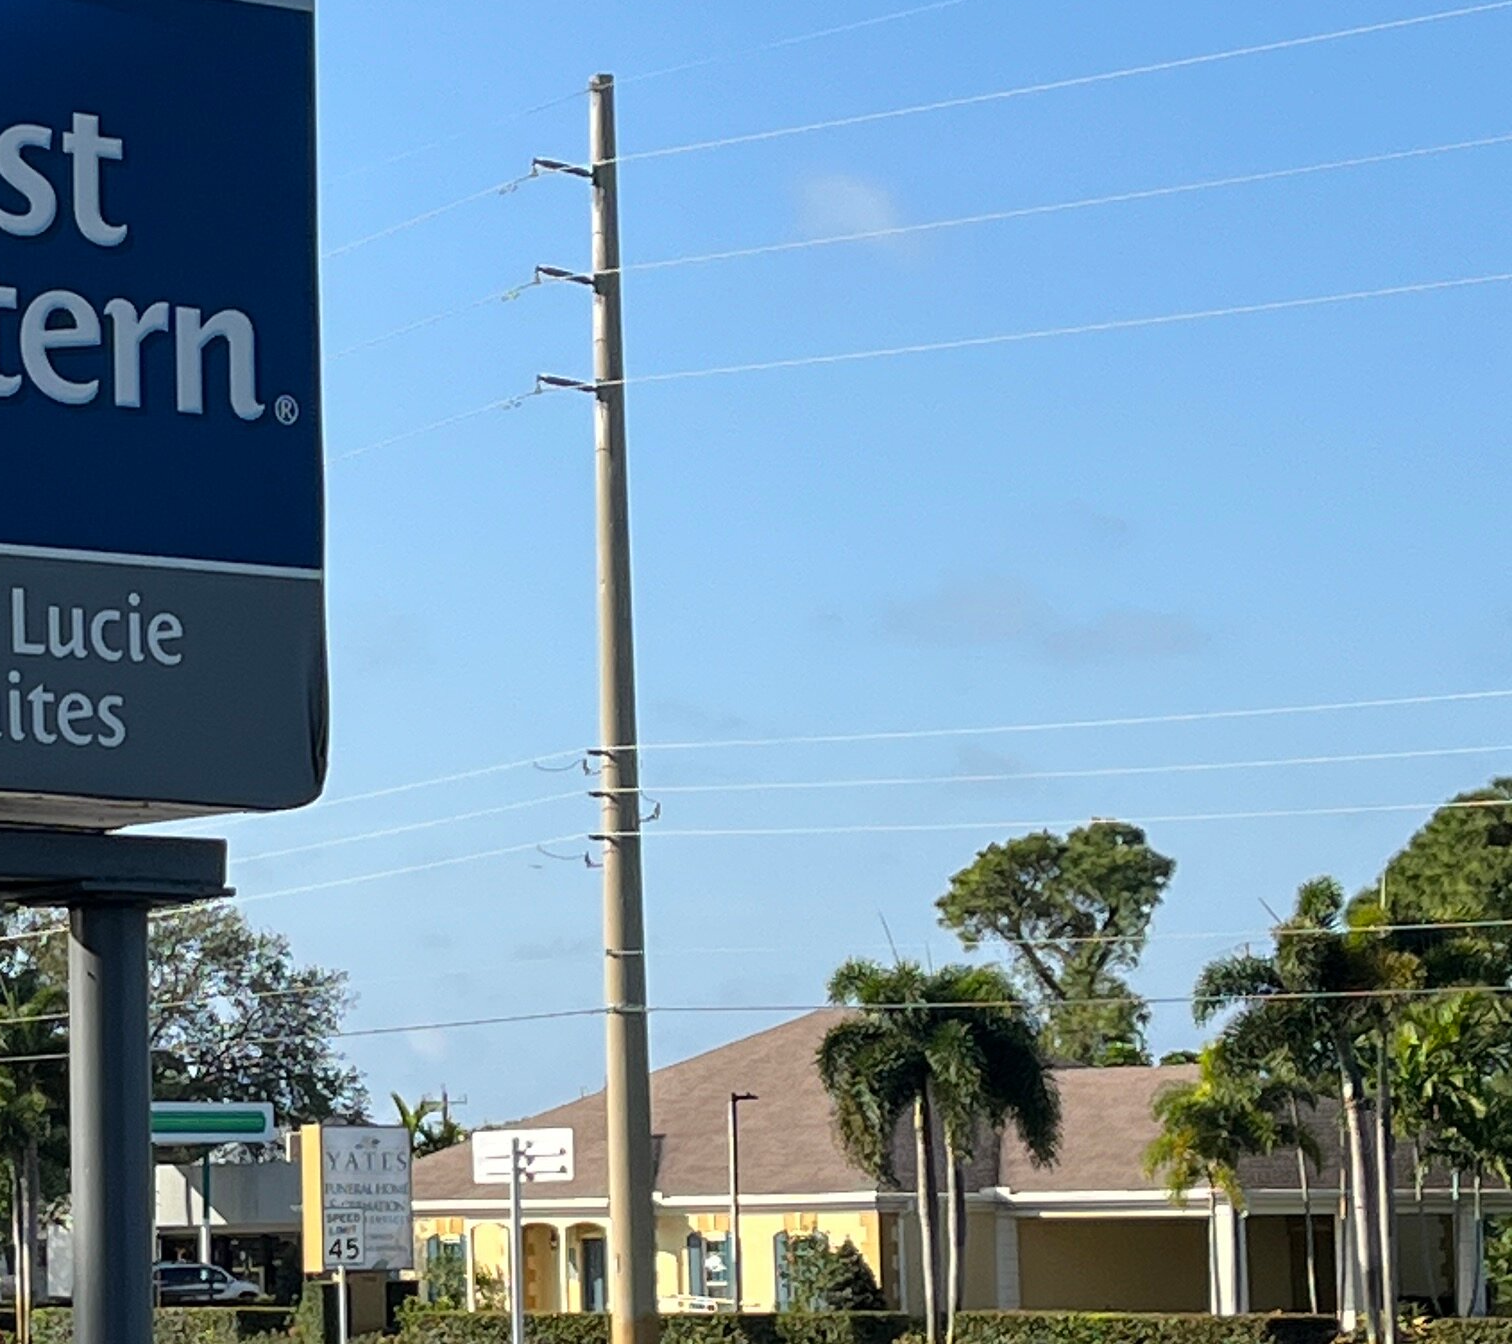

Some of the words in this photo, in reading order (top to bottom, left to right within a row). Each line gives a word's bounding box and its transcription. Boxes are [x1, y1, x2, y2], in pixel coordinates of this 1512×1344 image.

[11, 587, 184, 666] Lucie
[325, 1151, 407, 1171] YATES
[326, 1213, 361, 1224] SPEED
[328, 1225, 357, 1236] LIMIT
[328, 1238, 360, 1259] 45
